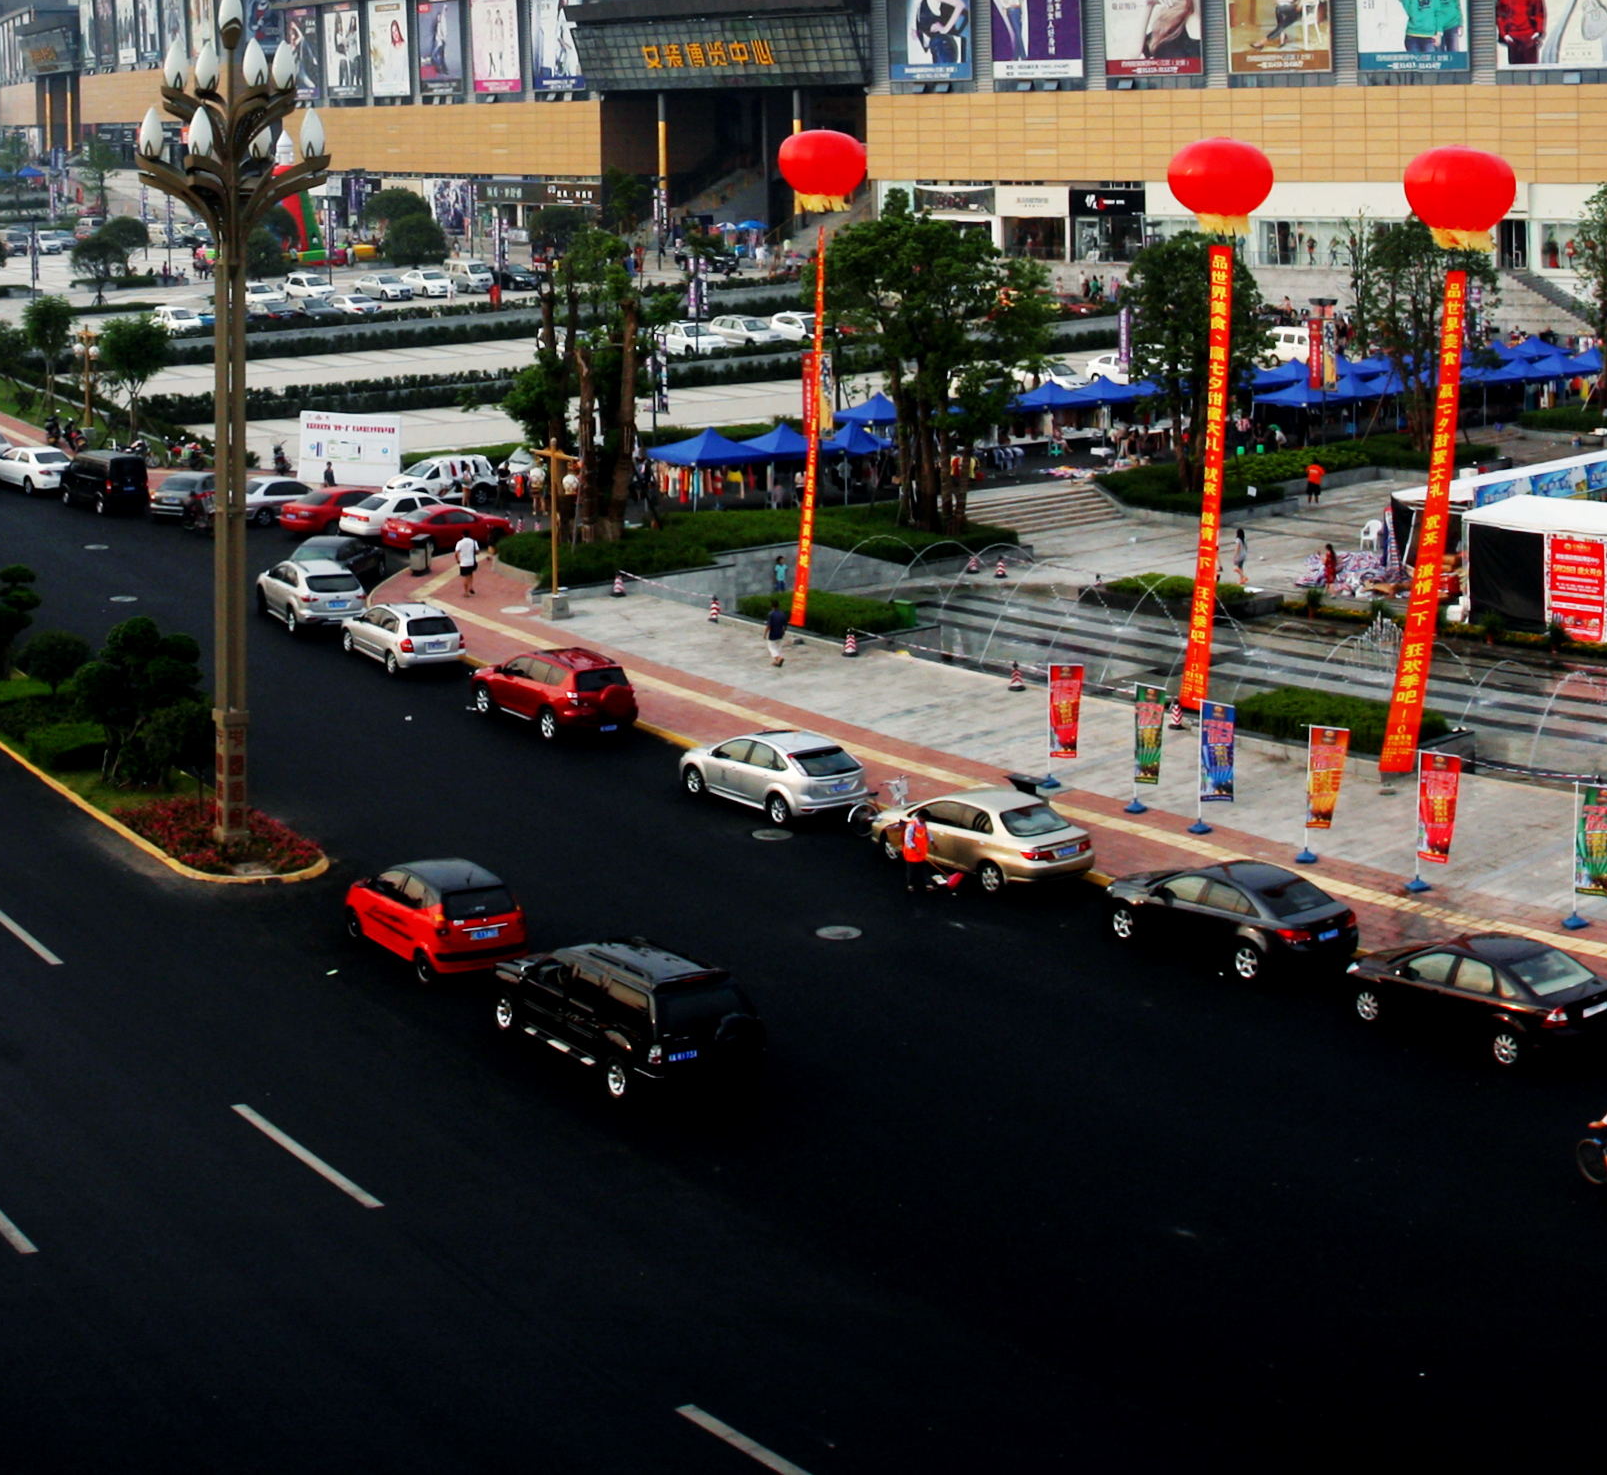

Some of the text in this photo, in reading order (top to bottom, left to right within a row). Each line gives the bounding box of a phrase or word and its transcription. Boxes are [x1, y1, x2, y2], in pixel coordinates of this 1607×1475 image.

[642, 39, 776, 69] 女装博览中心
